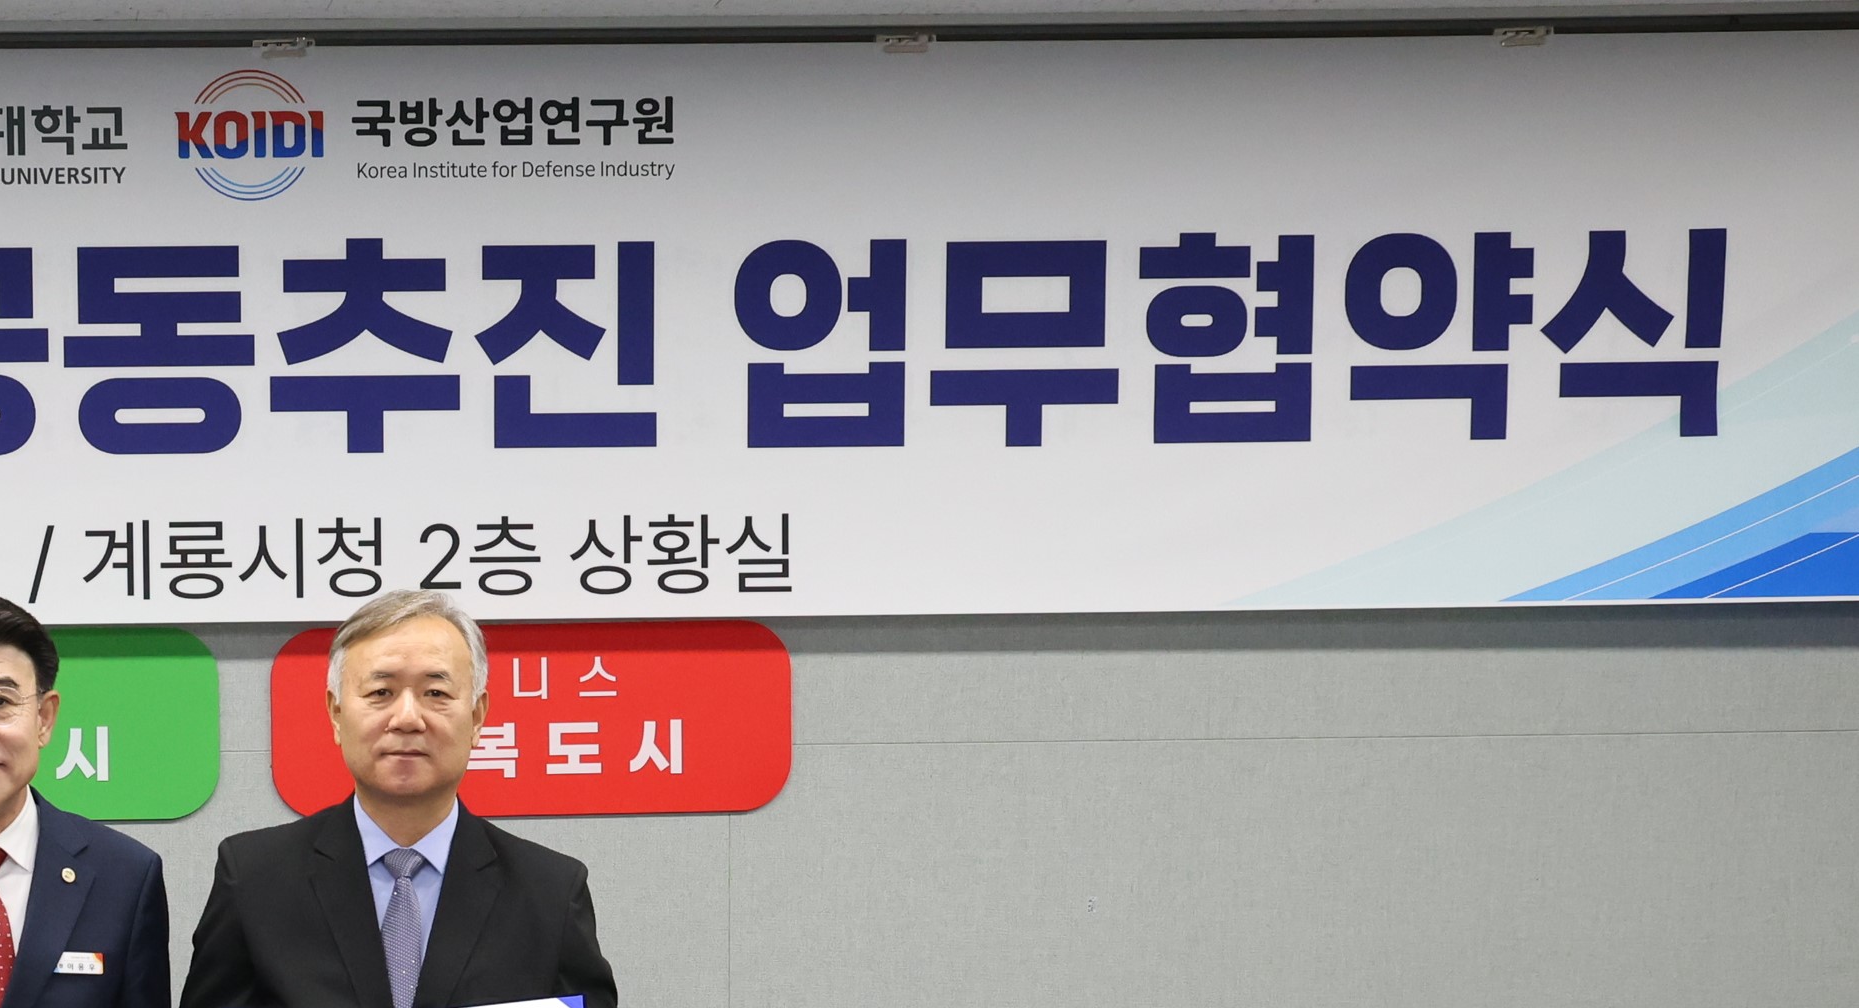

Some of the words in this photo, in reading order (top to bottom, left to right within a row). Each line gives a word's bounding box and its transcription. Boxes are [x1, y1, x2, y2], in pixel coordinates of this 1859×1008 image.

[174, 109, 325, 159] KOIDI
[351, 95, 675, 148] 국방산업연구원
[0, 166, 127, 186] UNIVERSITY
[357, 162, 408, 179] Korea
[413, 160, 487, 179] Institute
[491, 160, 518, 178] for
[522, 160, 596, 178] Defense
[600, 160, 676, 181] Industry
[734, 228, 1727, 448] 업무협약식
[82, 516, 385, 599] 계룡시청
[419, 515, 542, 593] 2층
[569, 512, 793, 596] 상황실
[512, 655, 618, 700] 니스
[464, 718, 684, 780] 복도시
